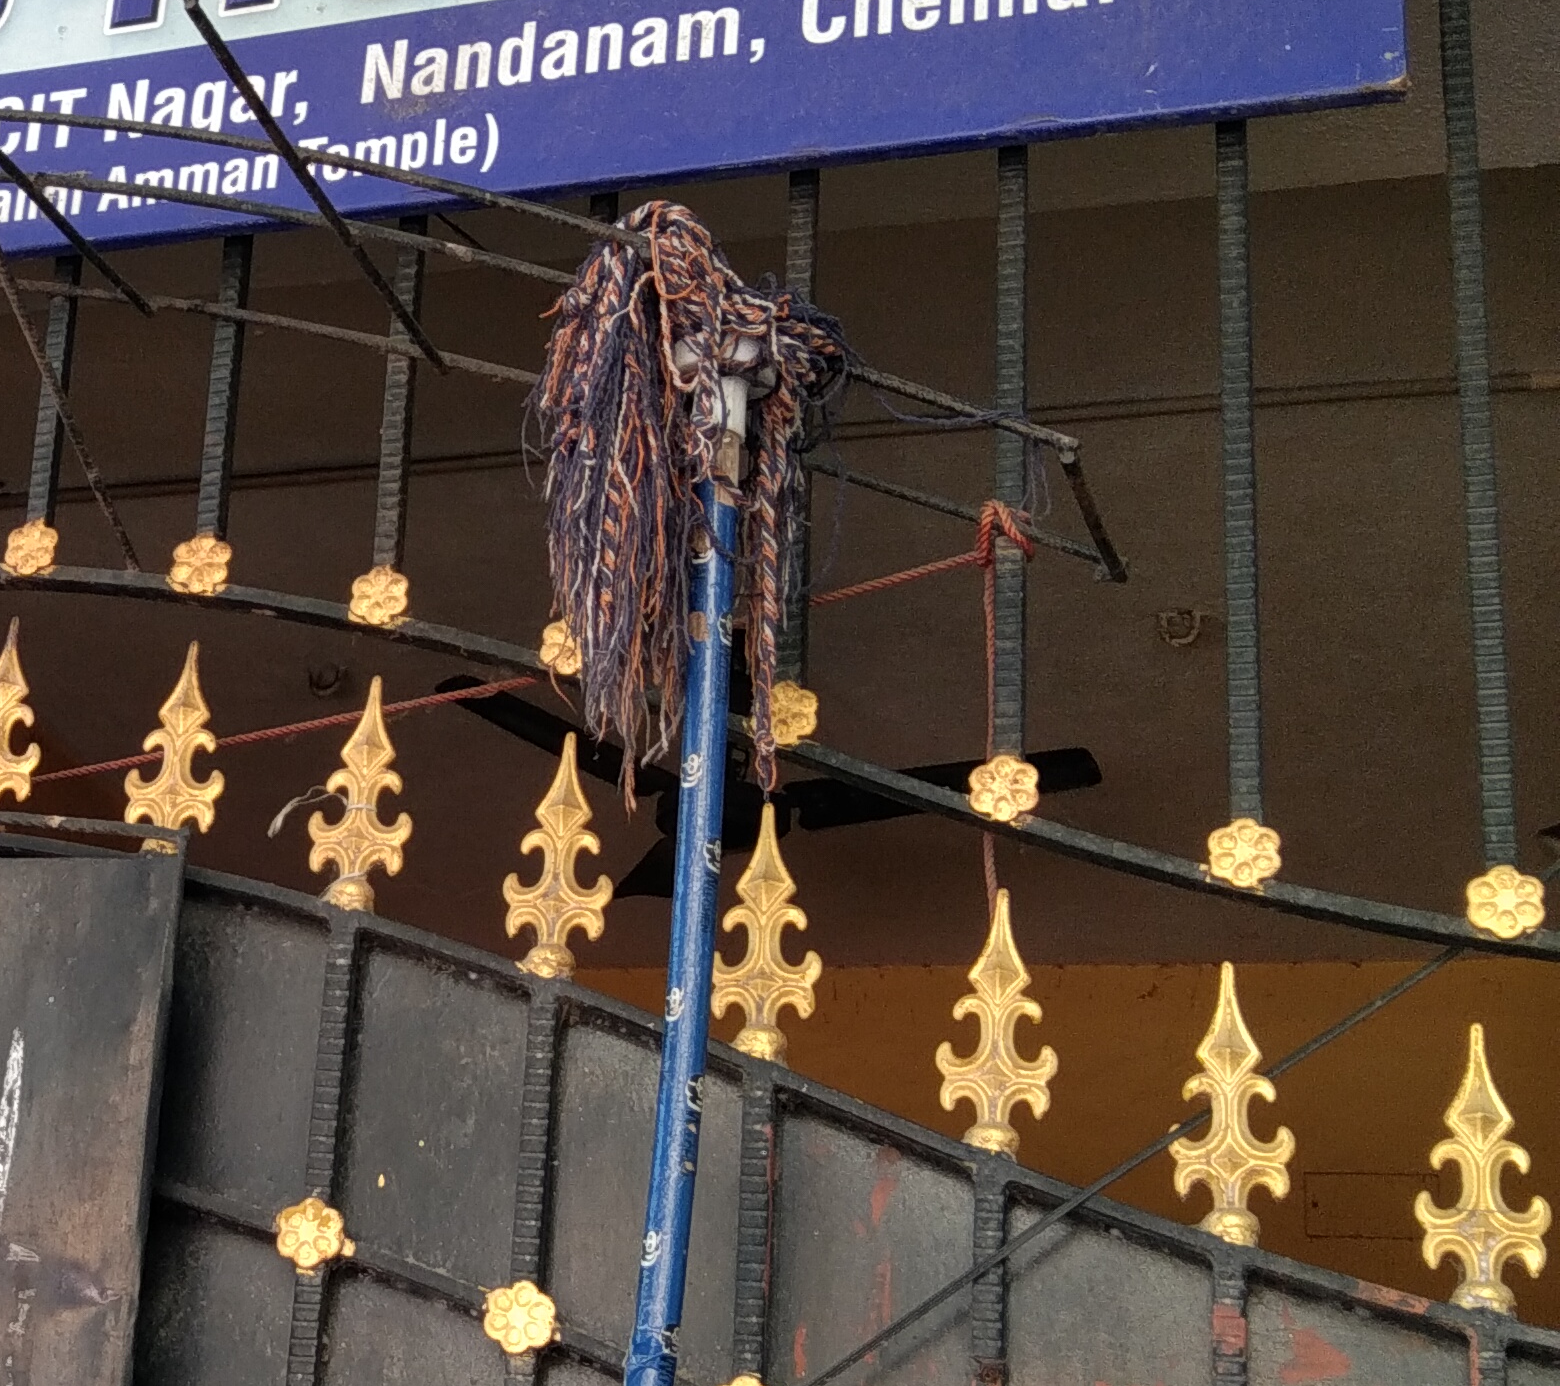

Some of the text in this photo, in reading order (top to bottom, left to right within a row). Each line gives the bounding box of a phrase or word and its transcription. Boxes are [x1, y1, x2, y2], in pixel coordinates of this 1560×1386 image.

[103, 69, 309, 143] Nagar,
[360, 6, 766, 104] Nandanam,
[96, 153, 280, 213] Amman
[298, 113, 500, 182] Temple)
